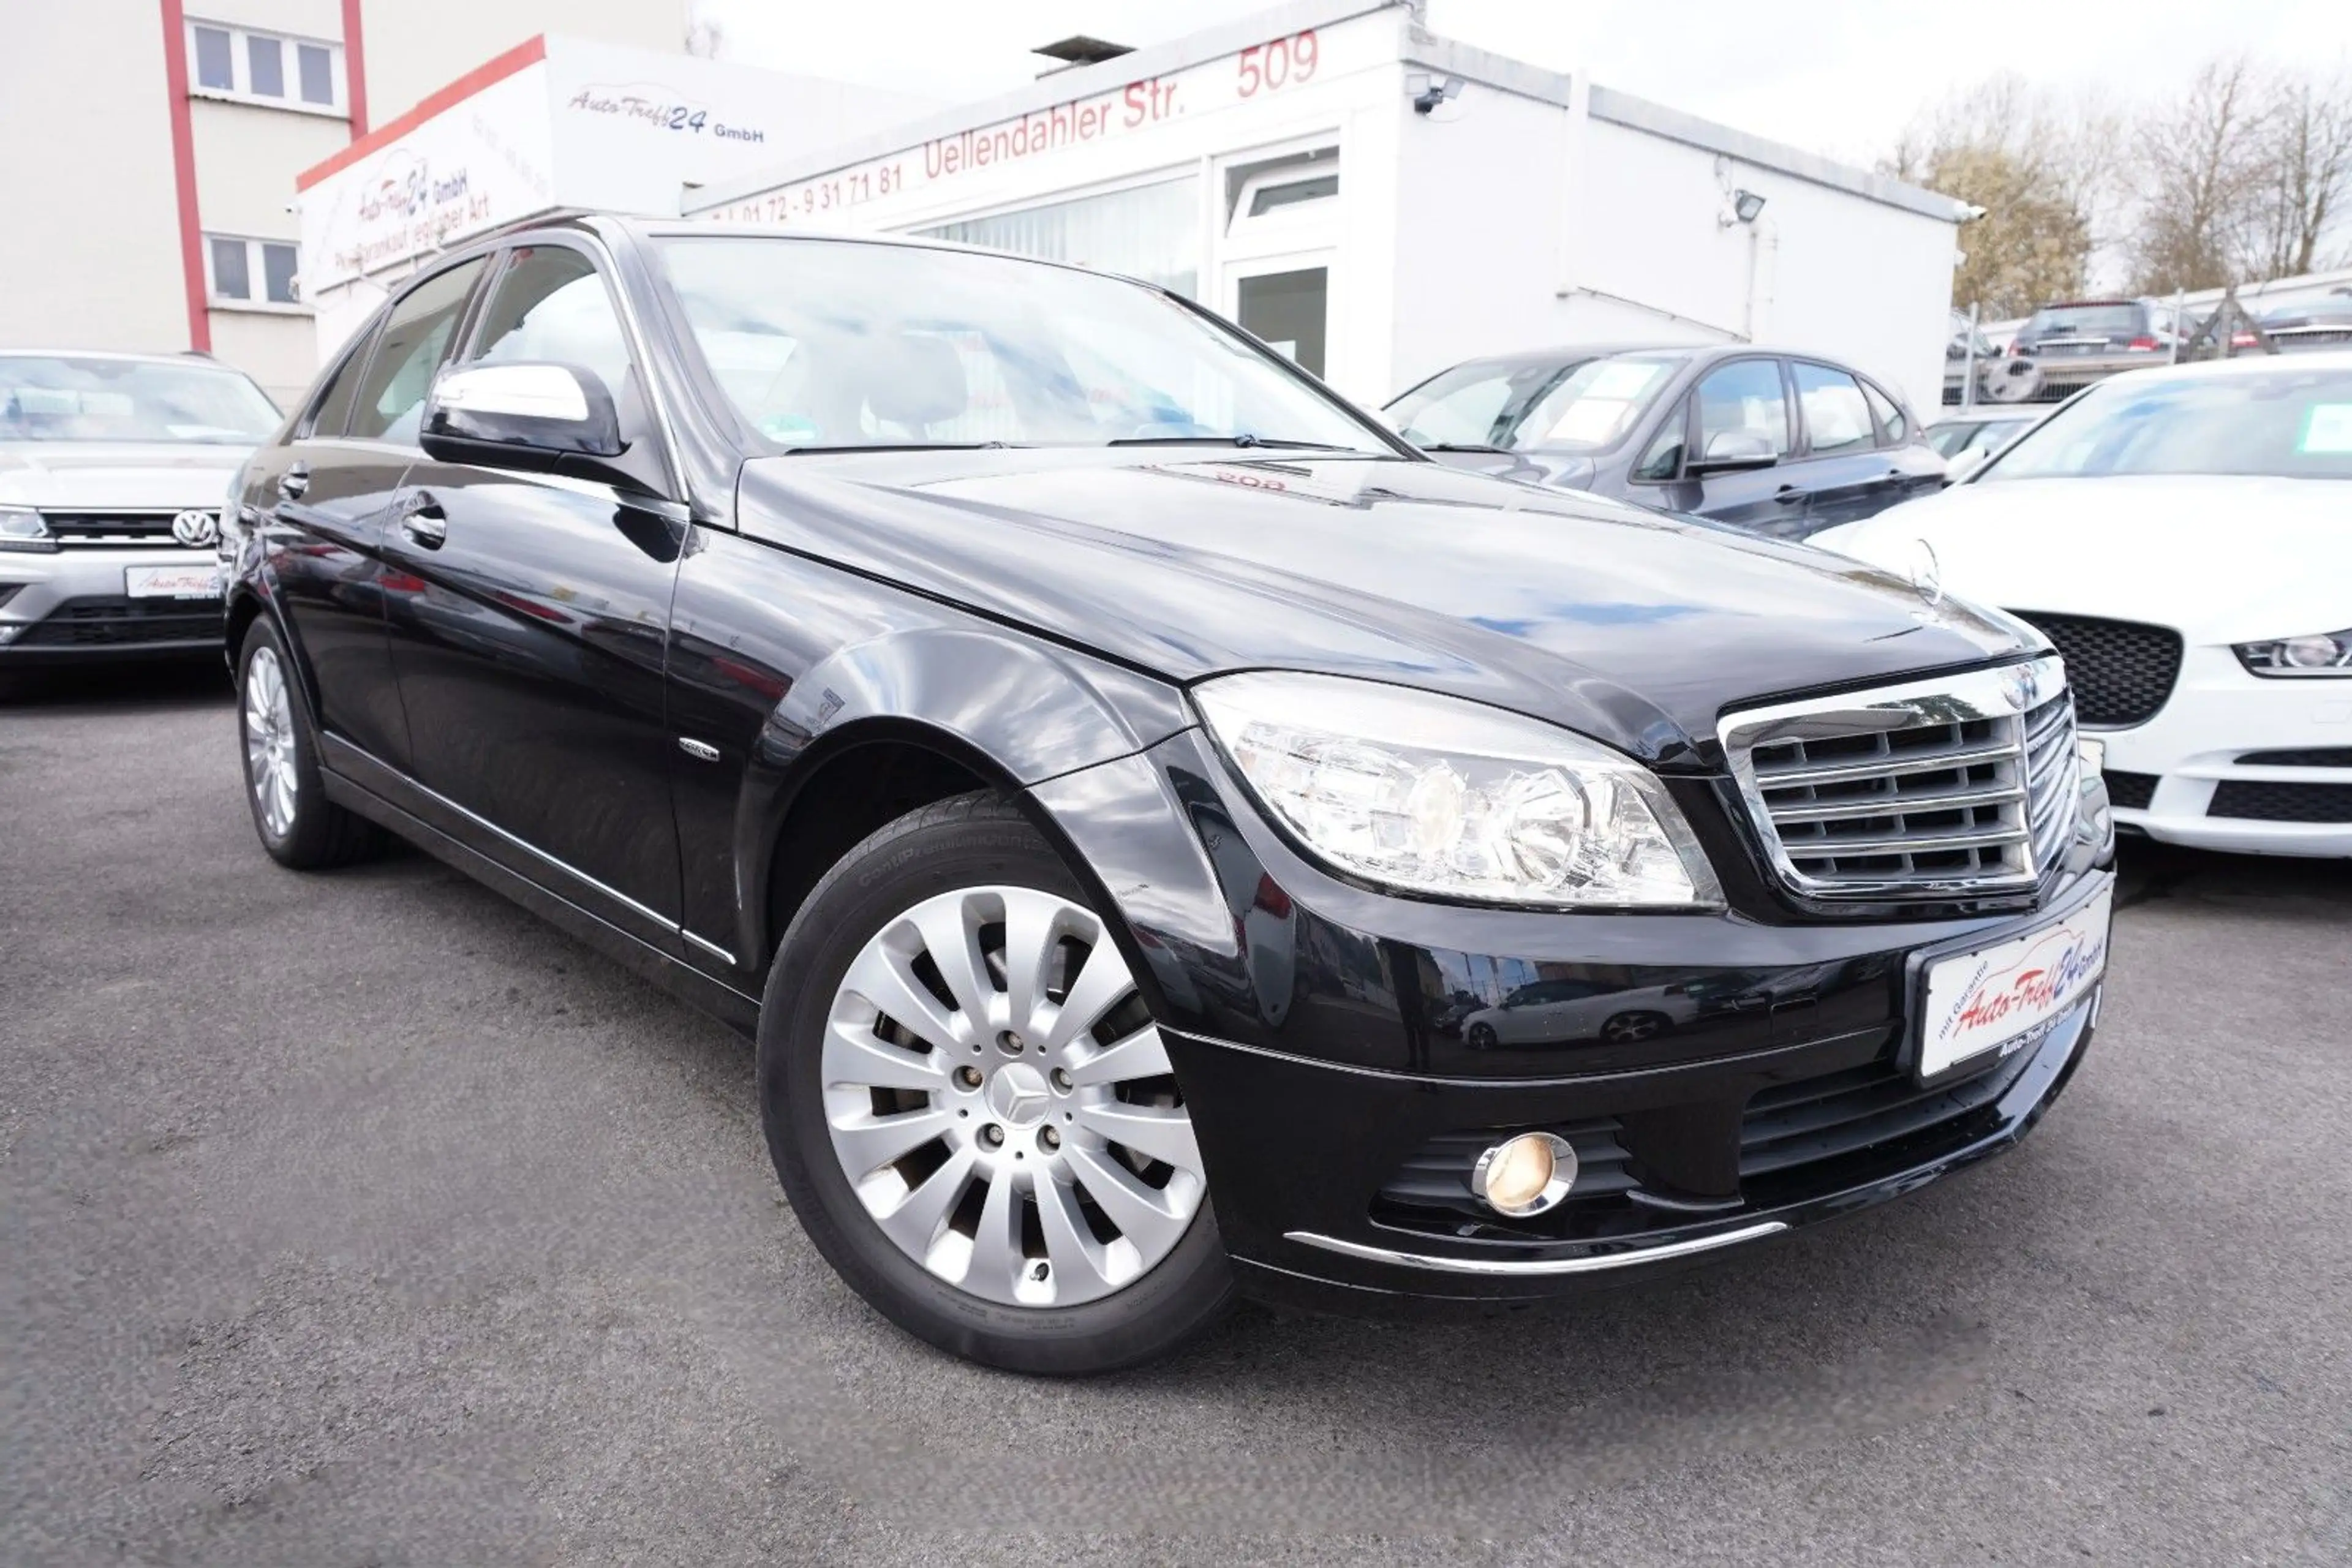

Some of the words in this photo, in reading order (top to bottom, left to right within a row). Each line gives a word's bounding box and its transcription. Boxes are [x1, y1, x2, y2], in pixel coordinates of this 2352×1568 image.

[714, 123, 764, 143] GmbH
[924, 100, 1112, 179] Uellendahler
[1123, 78, 1185, 127] Str.
[1237, 29, 1318, 99] 509
